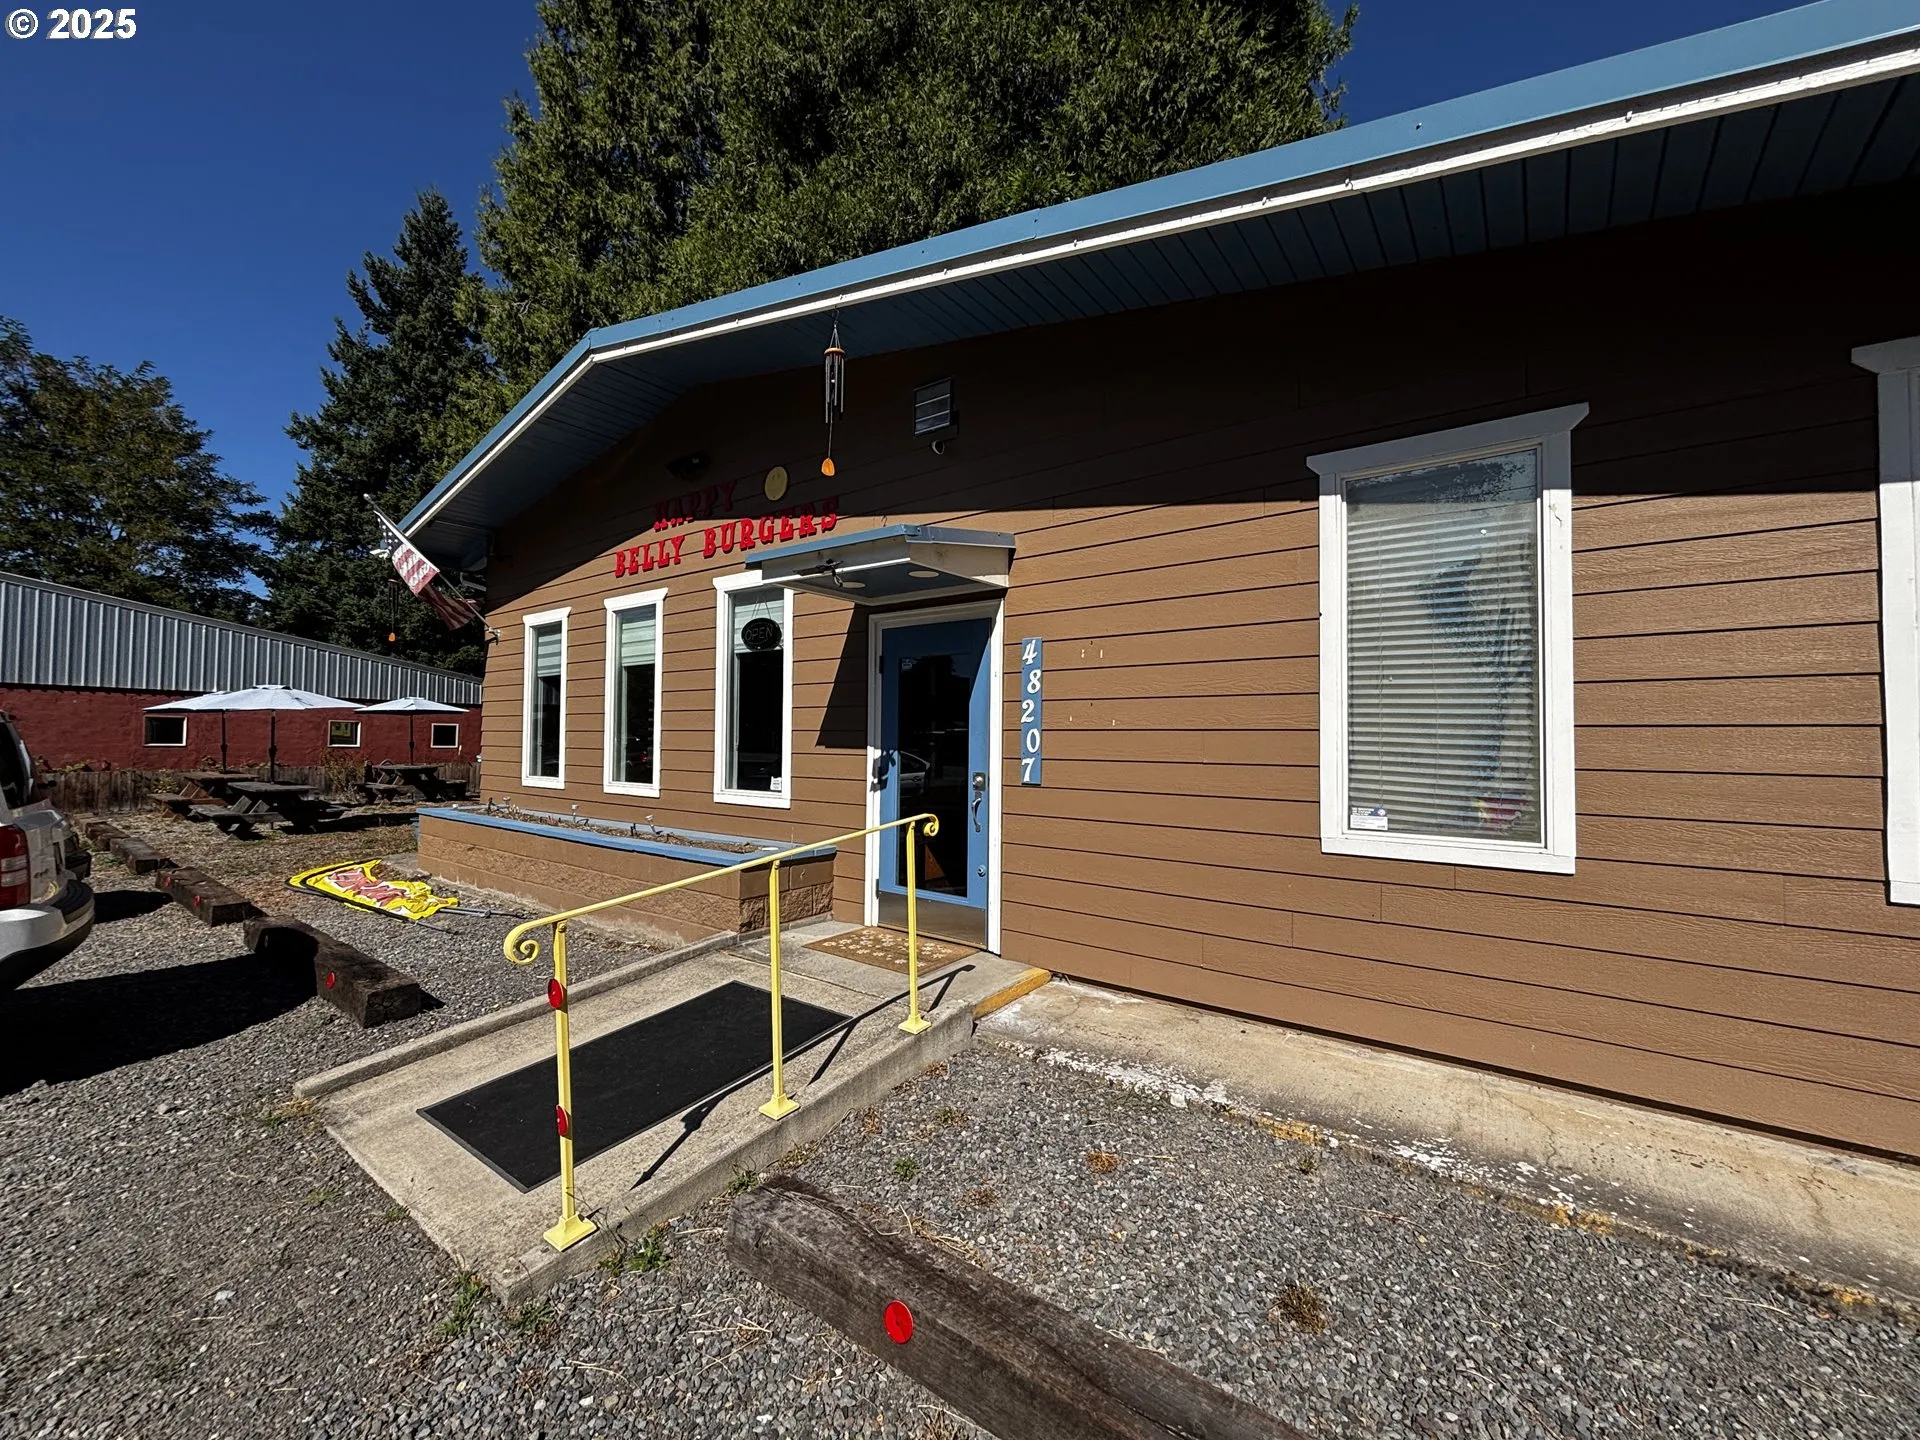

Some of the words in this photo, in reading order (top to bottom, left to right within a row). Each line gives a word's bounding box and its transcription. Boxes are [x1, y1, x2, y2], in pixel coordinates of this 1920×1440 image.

[615, 535, 686, 577] BELLY
[703, 496, 840, 558] BURGERS
[653, 480, 738, 531] HAPPY
[744, 627, 774, 641] OPEN
[1020, 640, 1041, 782] 48207
